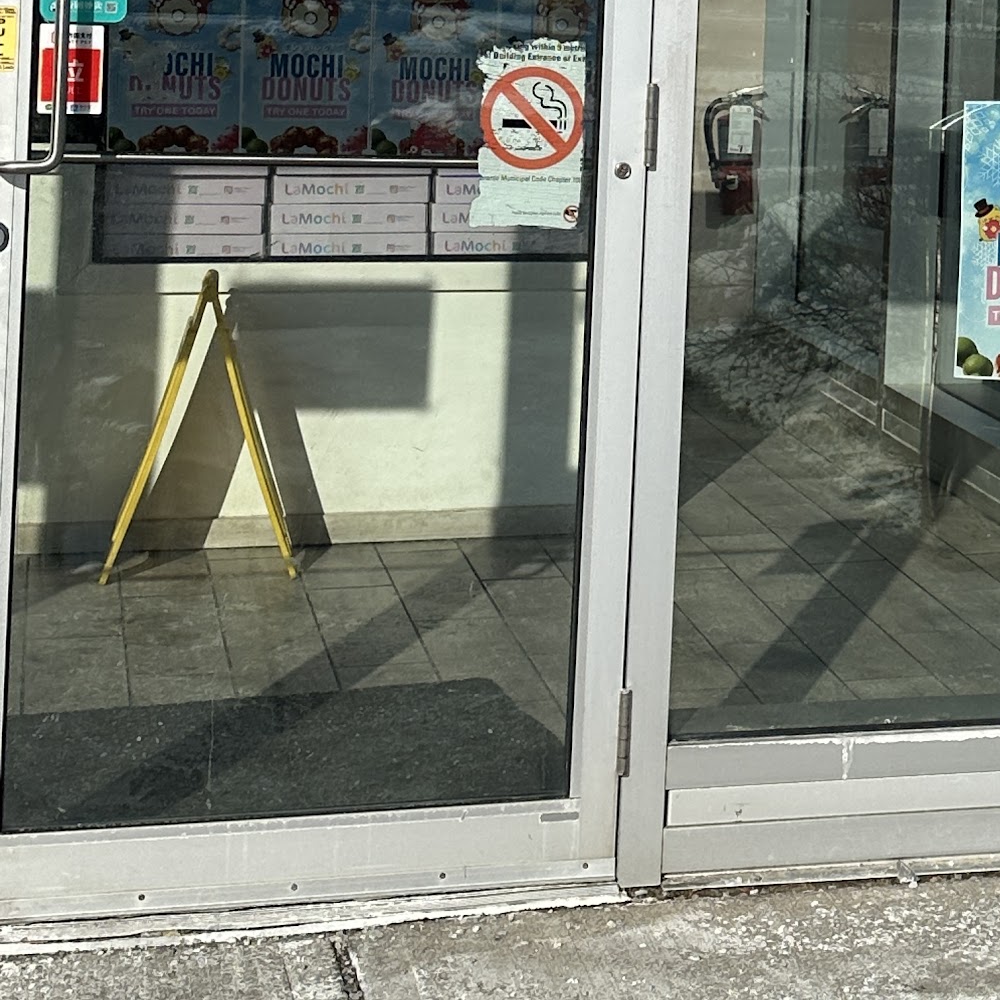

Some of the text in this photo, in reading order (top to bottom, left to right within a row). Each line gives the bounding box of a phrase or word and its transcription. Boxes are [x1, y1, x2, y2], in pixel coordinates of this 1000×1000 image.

[493, 52, 526, 61] Building
[528, 53, 562, 61] Entrance
[270, 53, 343, 78] MOCHI
[399, 56, 470, 81] MOCHI
[262, 77, 351, 102] DONUTS
[285, 183, 349, 196] LaMochi
[282, 212, 346, 224] LaMochi
[281, 242, 346, 254] LaMochi
[445, 240, 506, 252] LaMochi
